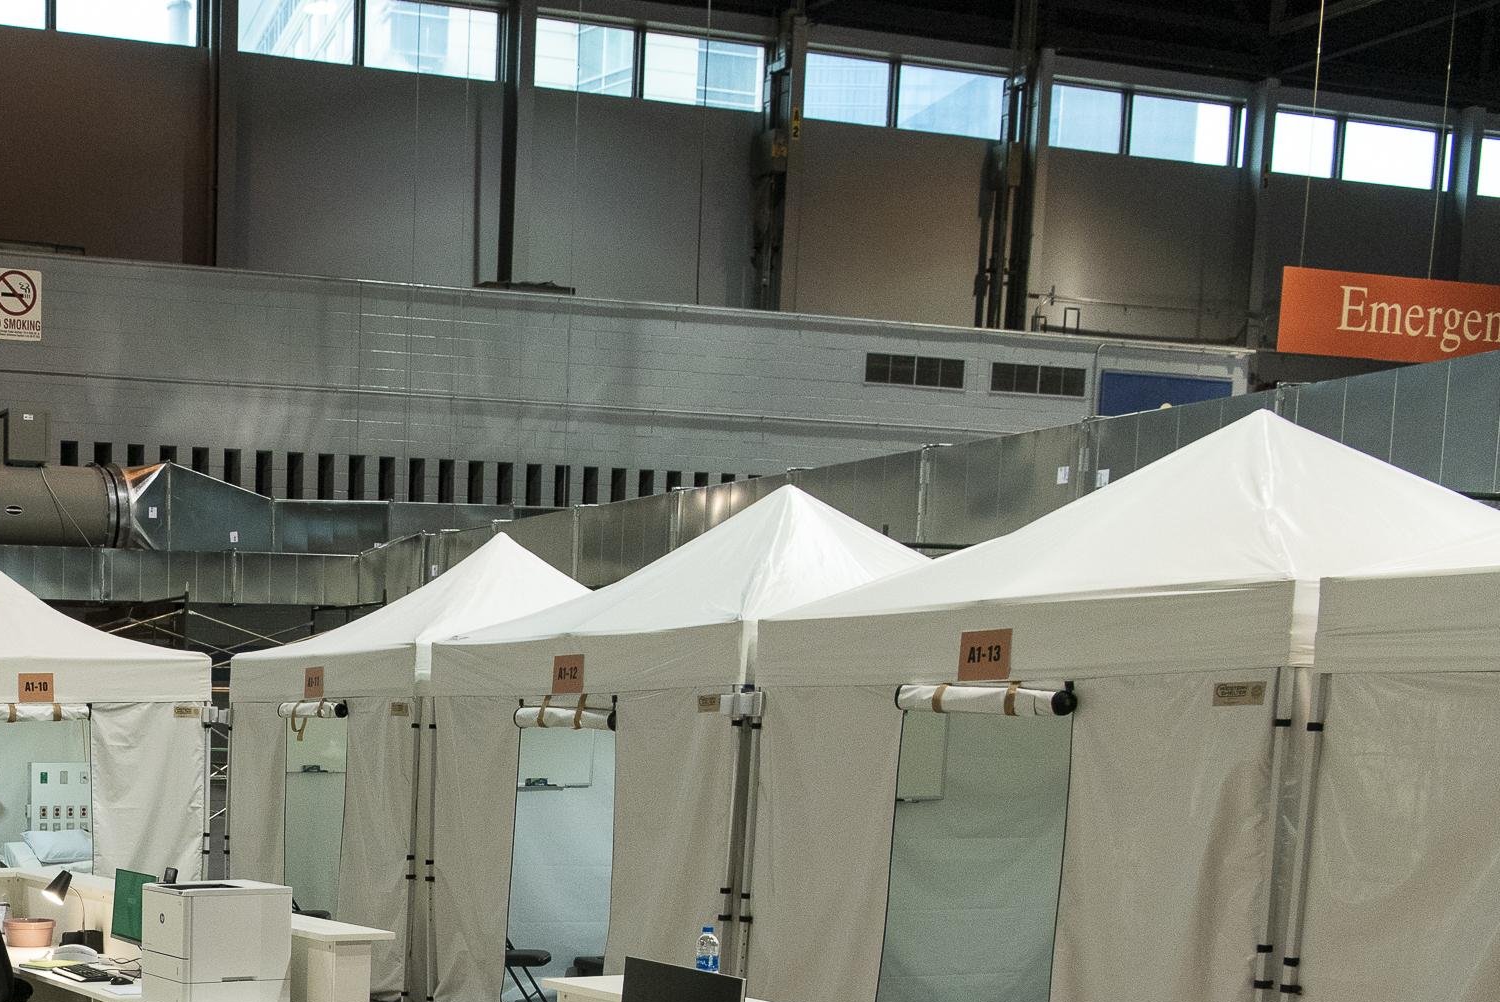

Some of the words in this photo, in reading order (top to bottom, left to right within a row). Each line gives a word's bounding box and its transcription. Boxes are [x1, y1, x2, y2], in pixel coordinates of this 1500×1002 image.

[3, 318, 41, 332] SMOKING
[967, 645, 1001, 664] A1-13
[557, 666, 578, 680] A1-12
[24, 681, 49, 692] A1-10
